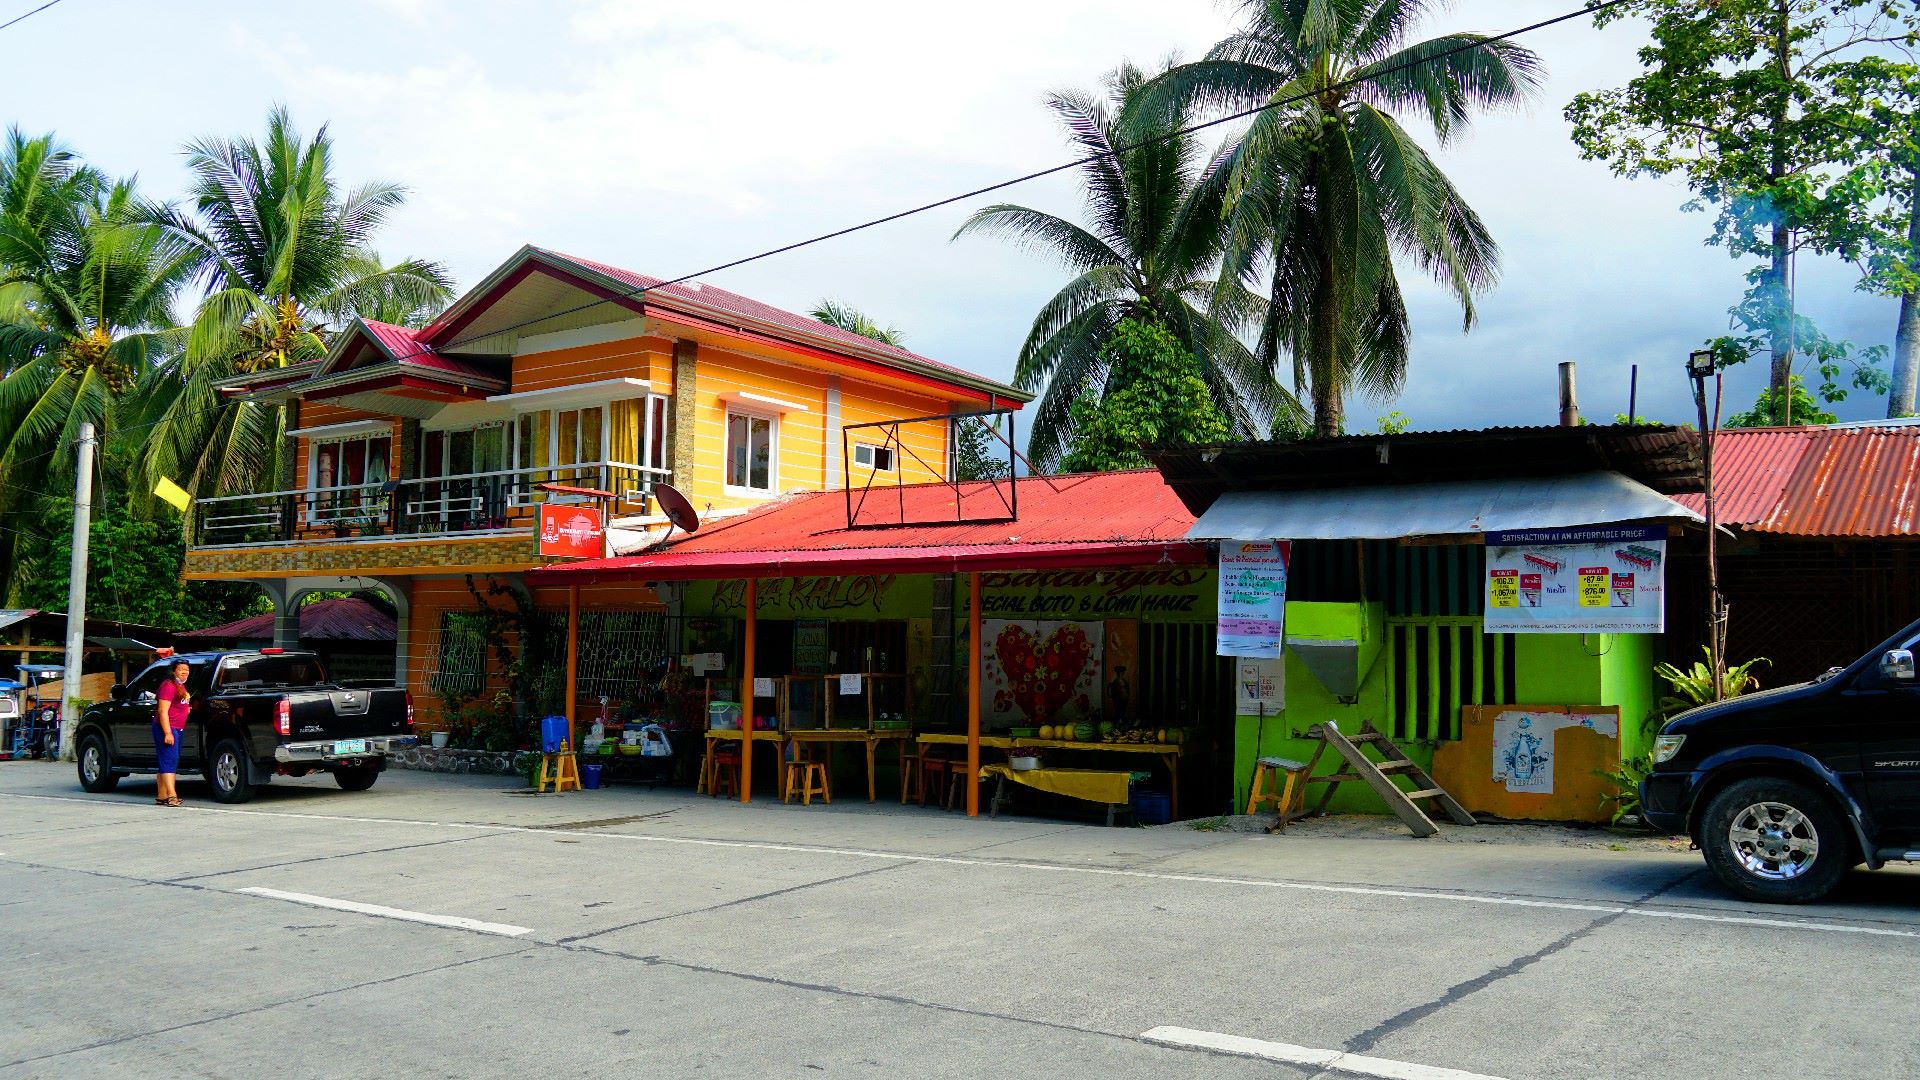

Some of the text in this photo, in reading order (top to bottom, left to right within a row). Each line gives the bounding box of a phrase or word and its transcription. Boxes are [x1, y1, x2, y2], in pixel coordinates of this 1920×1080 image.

[1501, 533, 1549, 543] SATISFACTION
[1562, 532, 1573, 541] AN
[1574, 530, 1620, 541] AFFORDABLE
[1621, 529, 1647, 539] PRICE!
[789, 575, 897, 613] KALOY
[1094, 595, 1141, 613] LOMI
[1142, 594, 1200, 612] HAUZ
